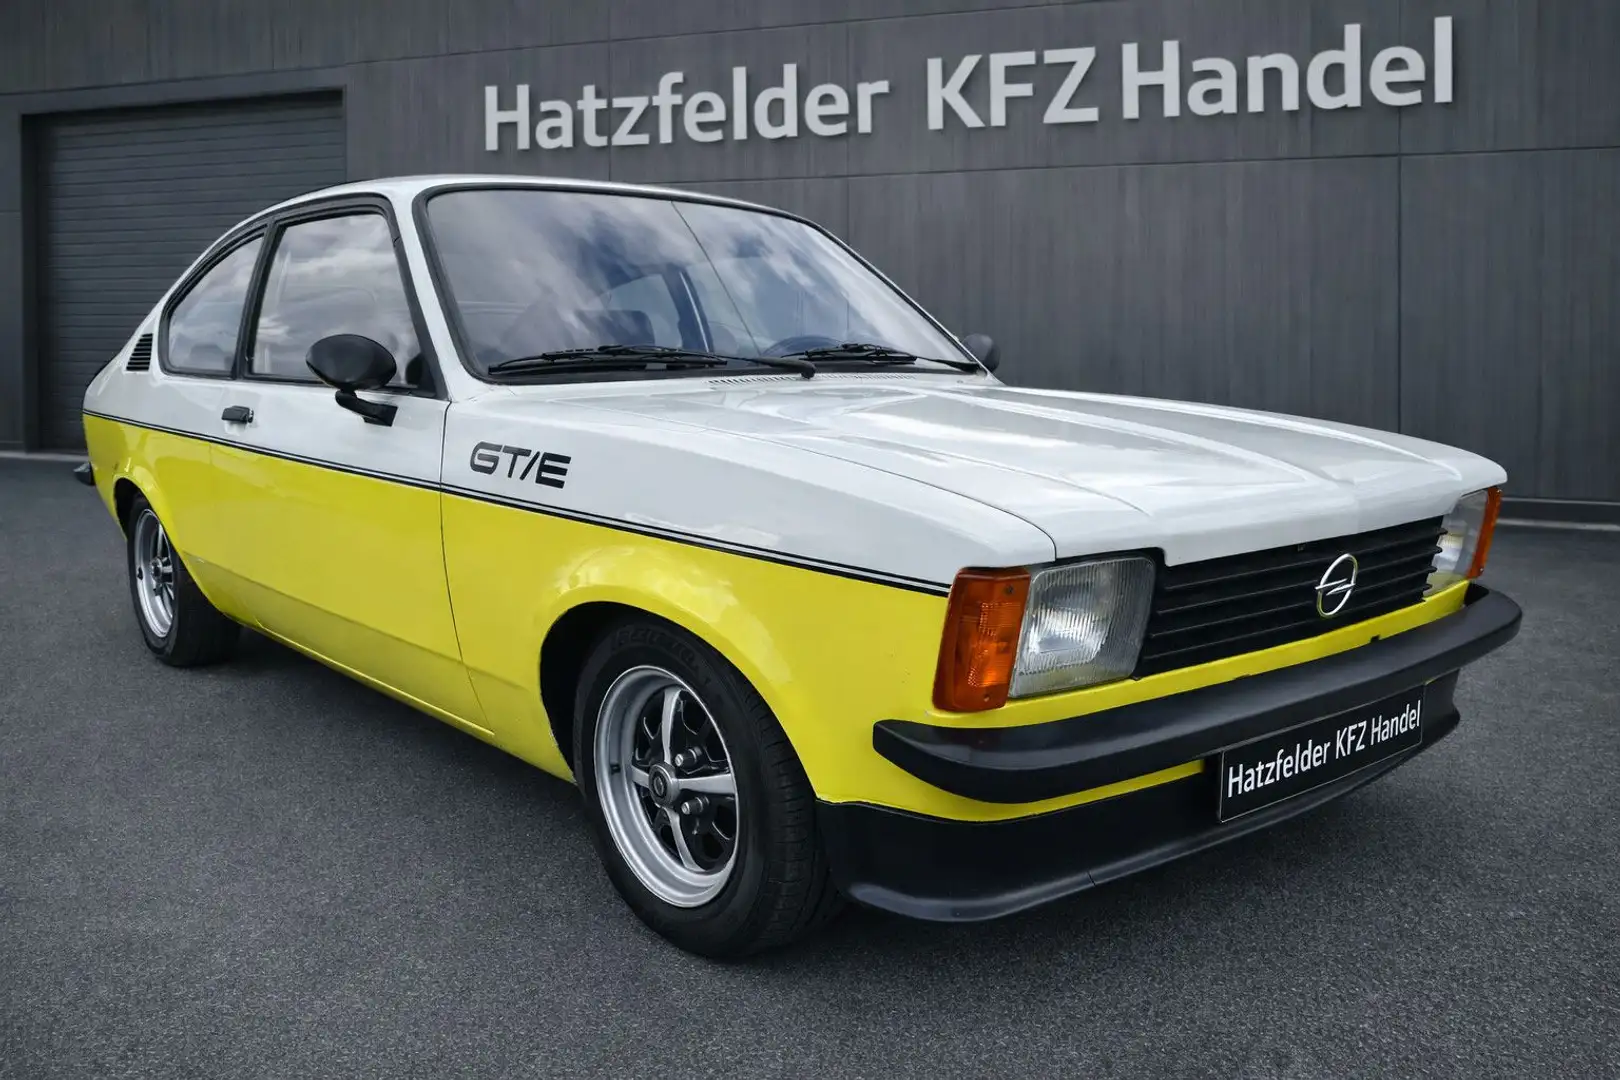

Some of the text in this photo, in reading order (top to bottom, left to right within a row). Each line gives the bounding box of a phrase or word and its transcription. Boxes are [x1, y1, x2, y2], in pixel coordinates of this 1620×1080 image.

[485, 16, 1453, 151] Hatzfelder KFZ Handel
[470, 441, 572, 489] GT/E
[1227, 699, 1421, 798] Hatzfelder KFZ Handel
